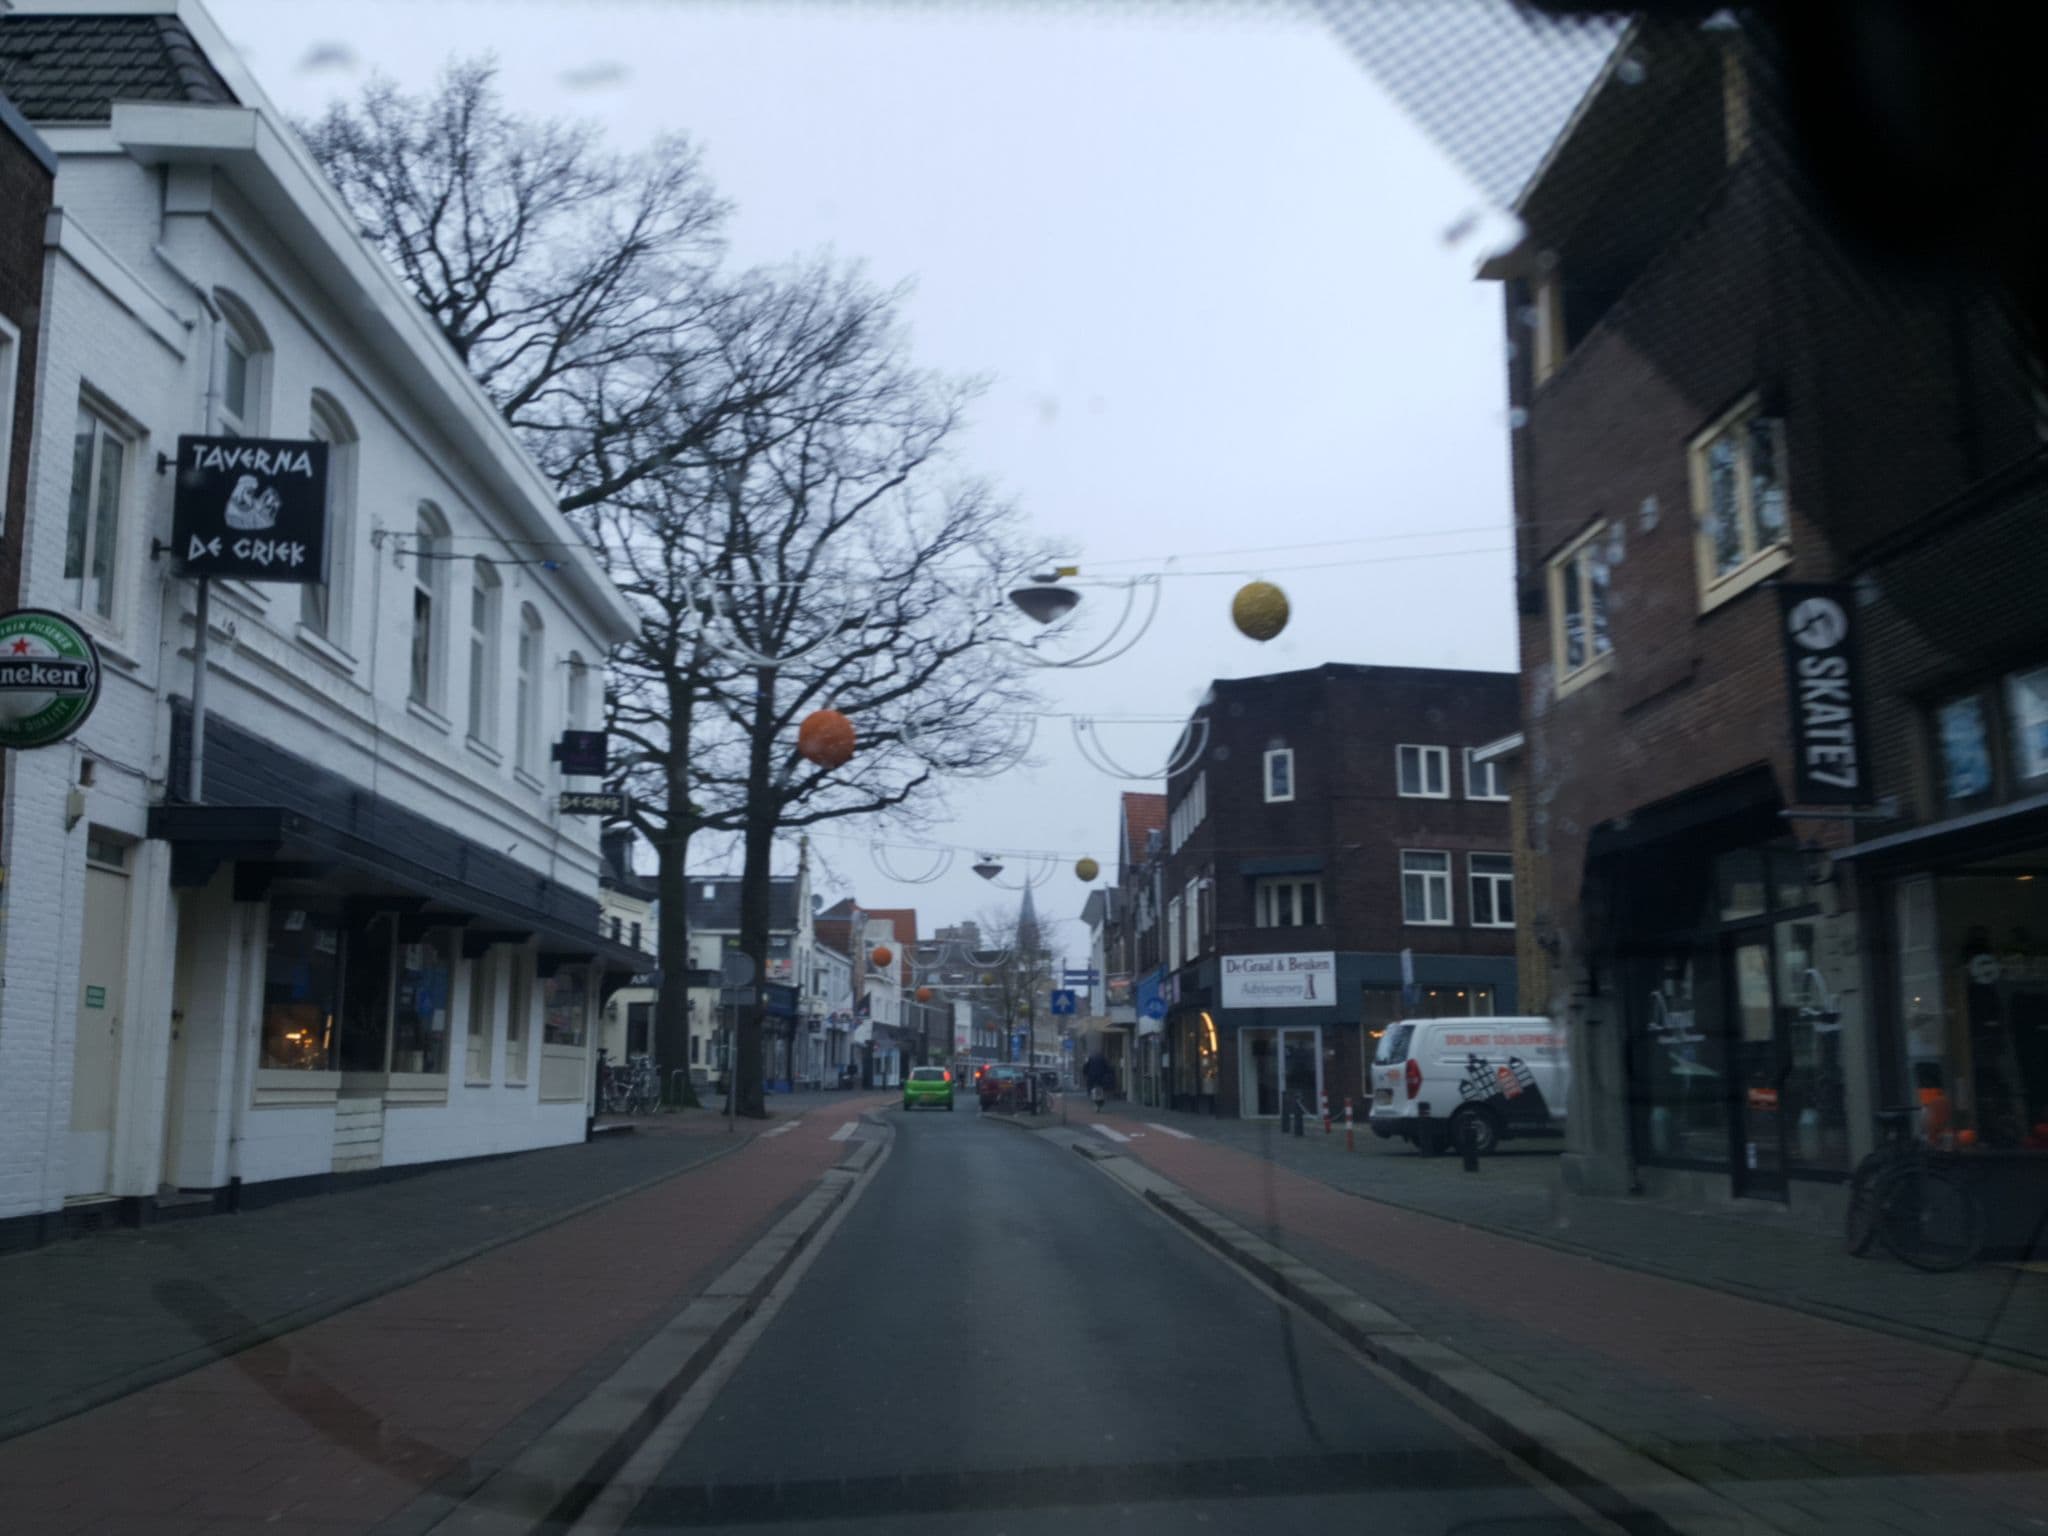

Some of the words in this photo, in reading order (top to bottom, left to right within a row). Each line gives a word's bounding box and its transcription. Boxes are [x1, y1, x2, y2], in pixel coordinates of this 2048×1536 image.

[192, 444, 313, 479] TAVERNA
[188, 533, 222, 561] DE
[1225, 959, 1241, 974] De
